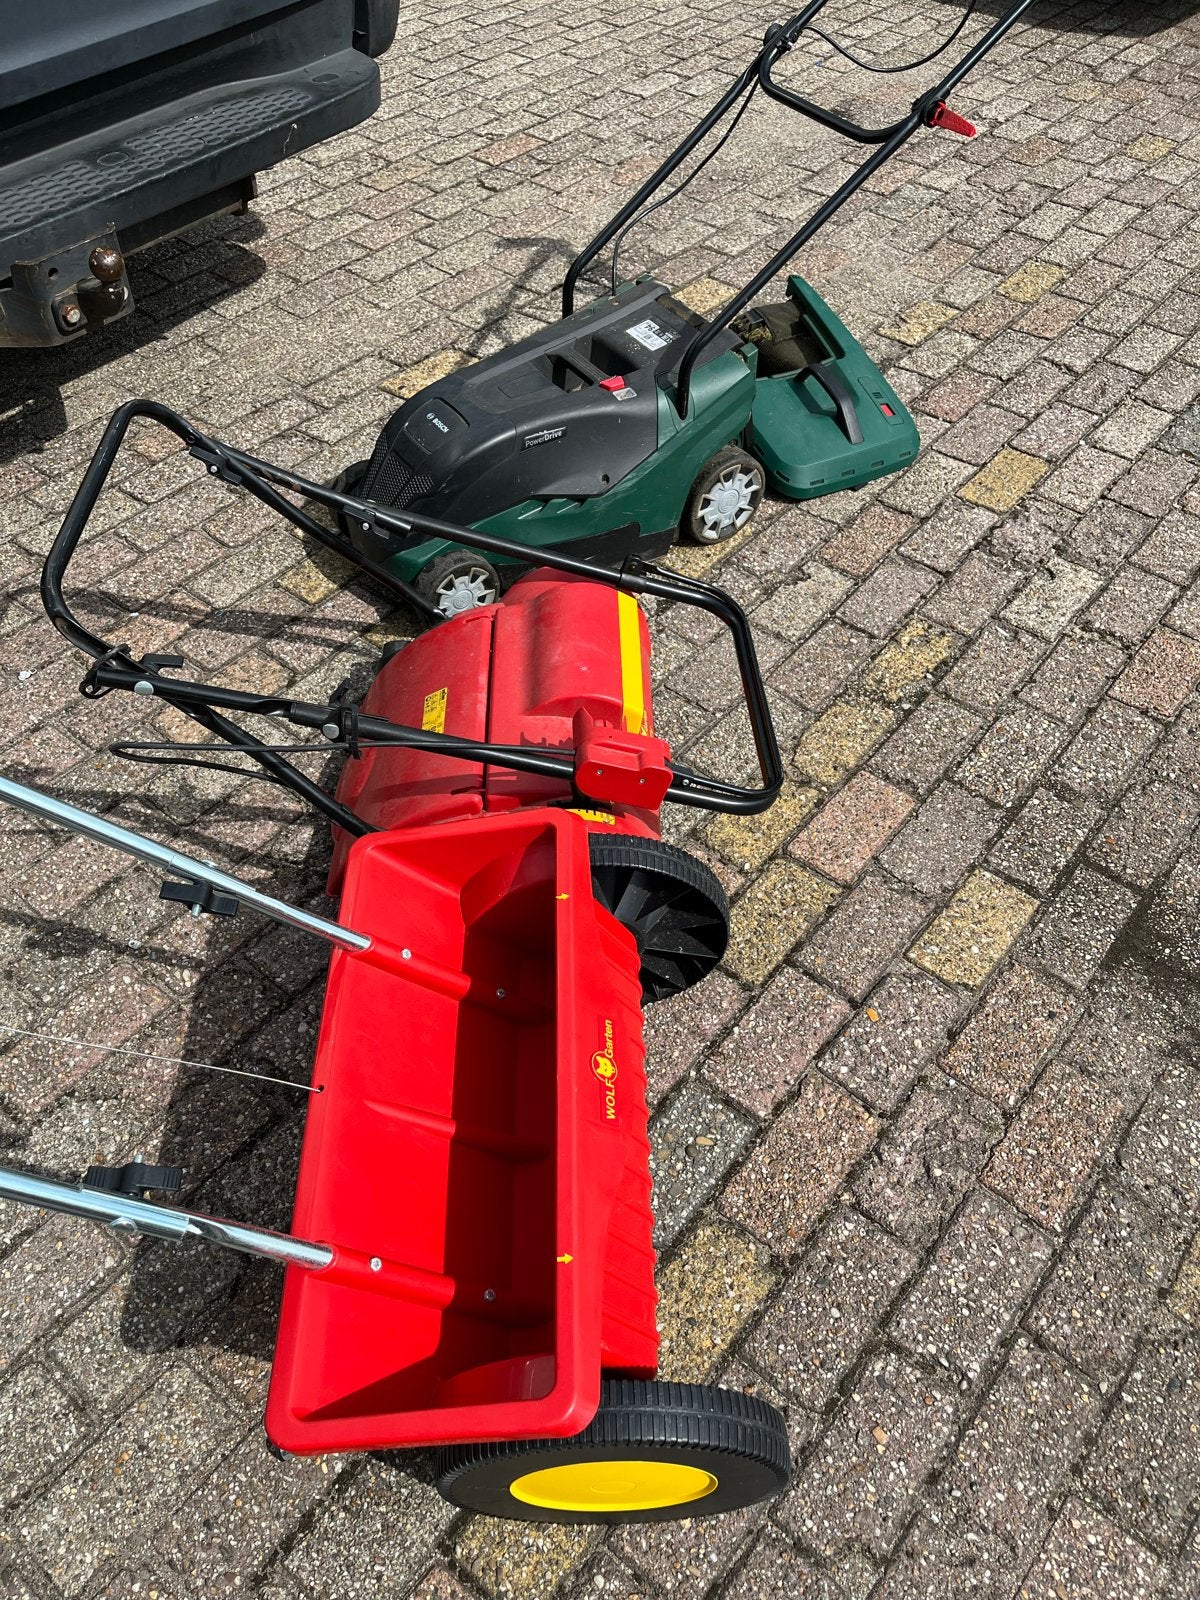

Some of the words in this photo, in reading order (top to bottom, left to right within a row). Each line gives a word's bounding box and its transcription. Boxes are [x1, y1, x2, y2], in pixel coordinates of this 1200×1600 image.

[432, 417, 450, 434] BOSCH
[525, 430, 562, 447] PowerDrive
[604, 1019, 614, 1059] Garten
[606, 1078, 616, 1119] WOLF
